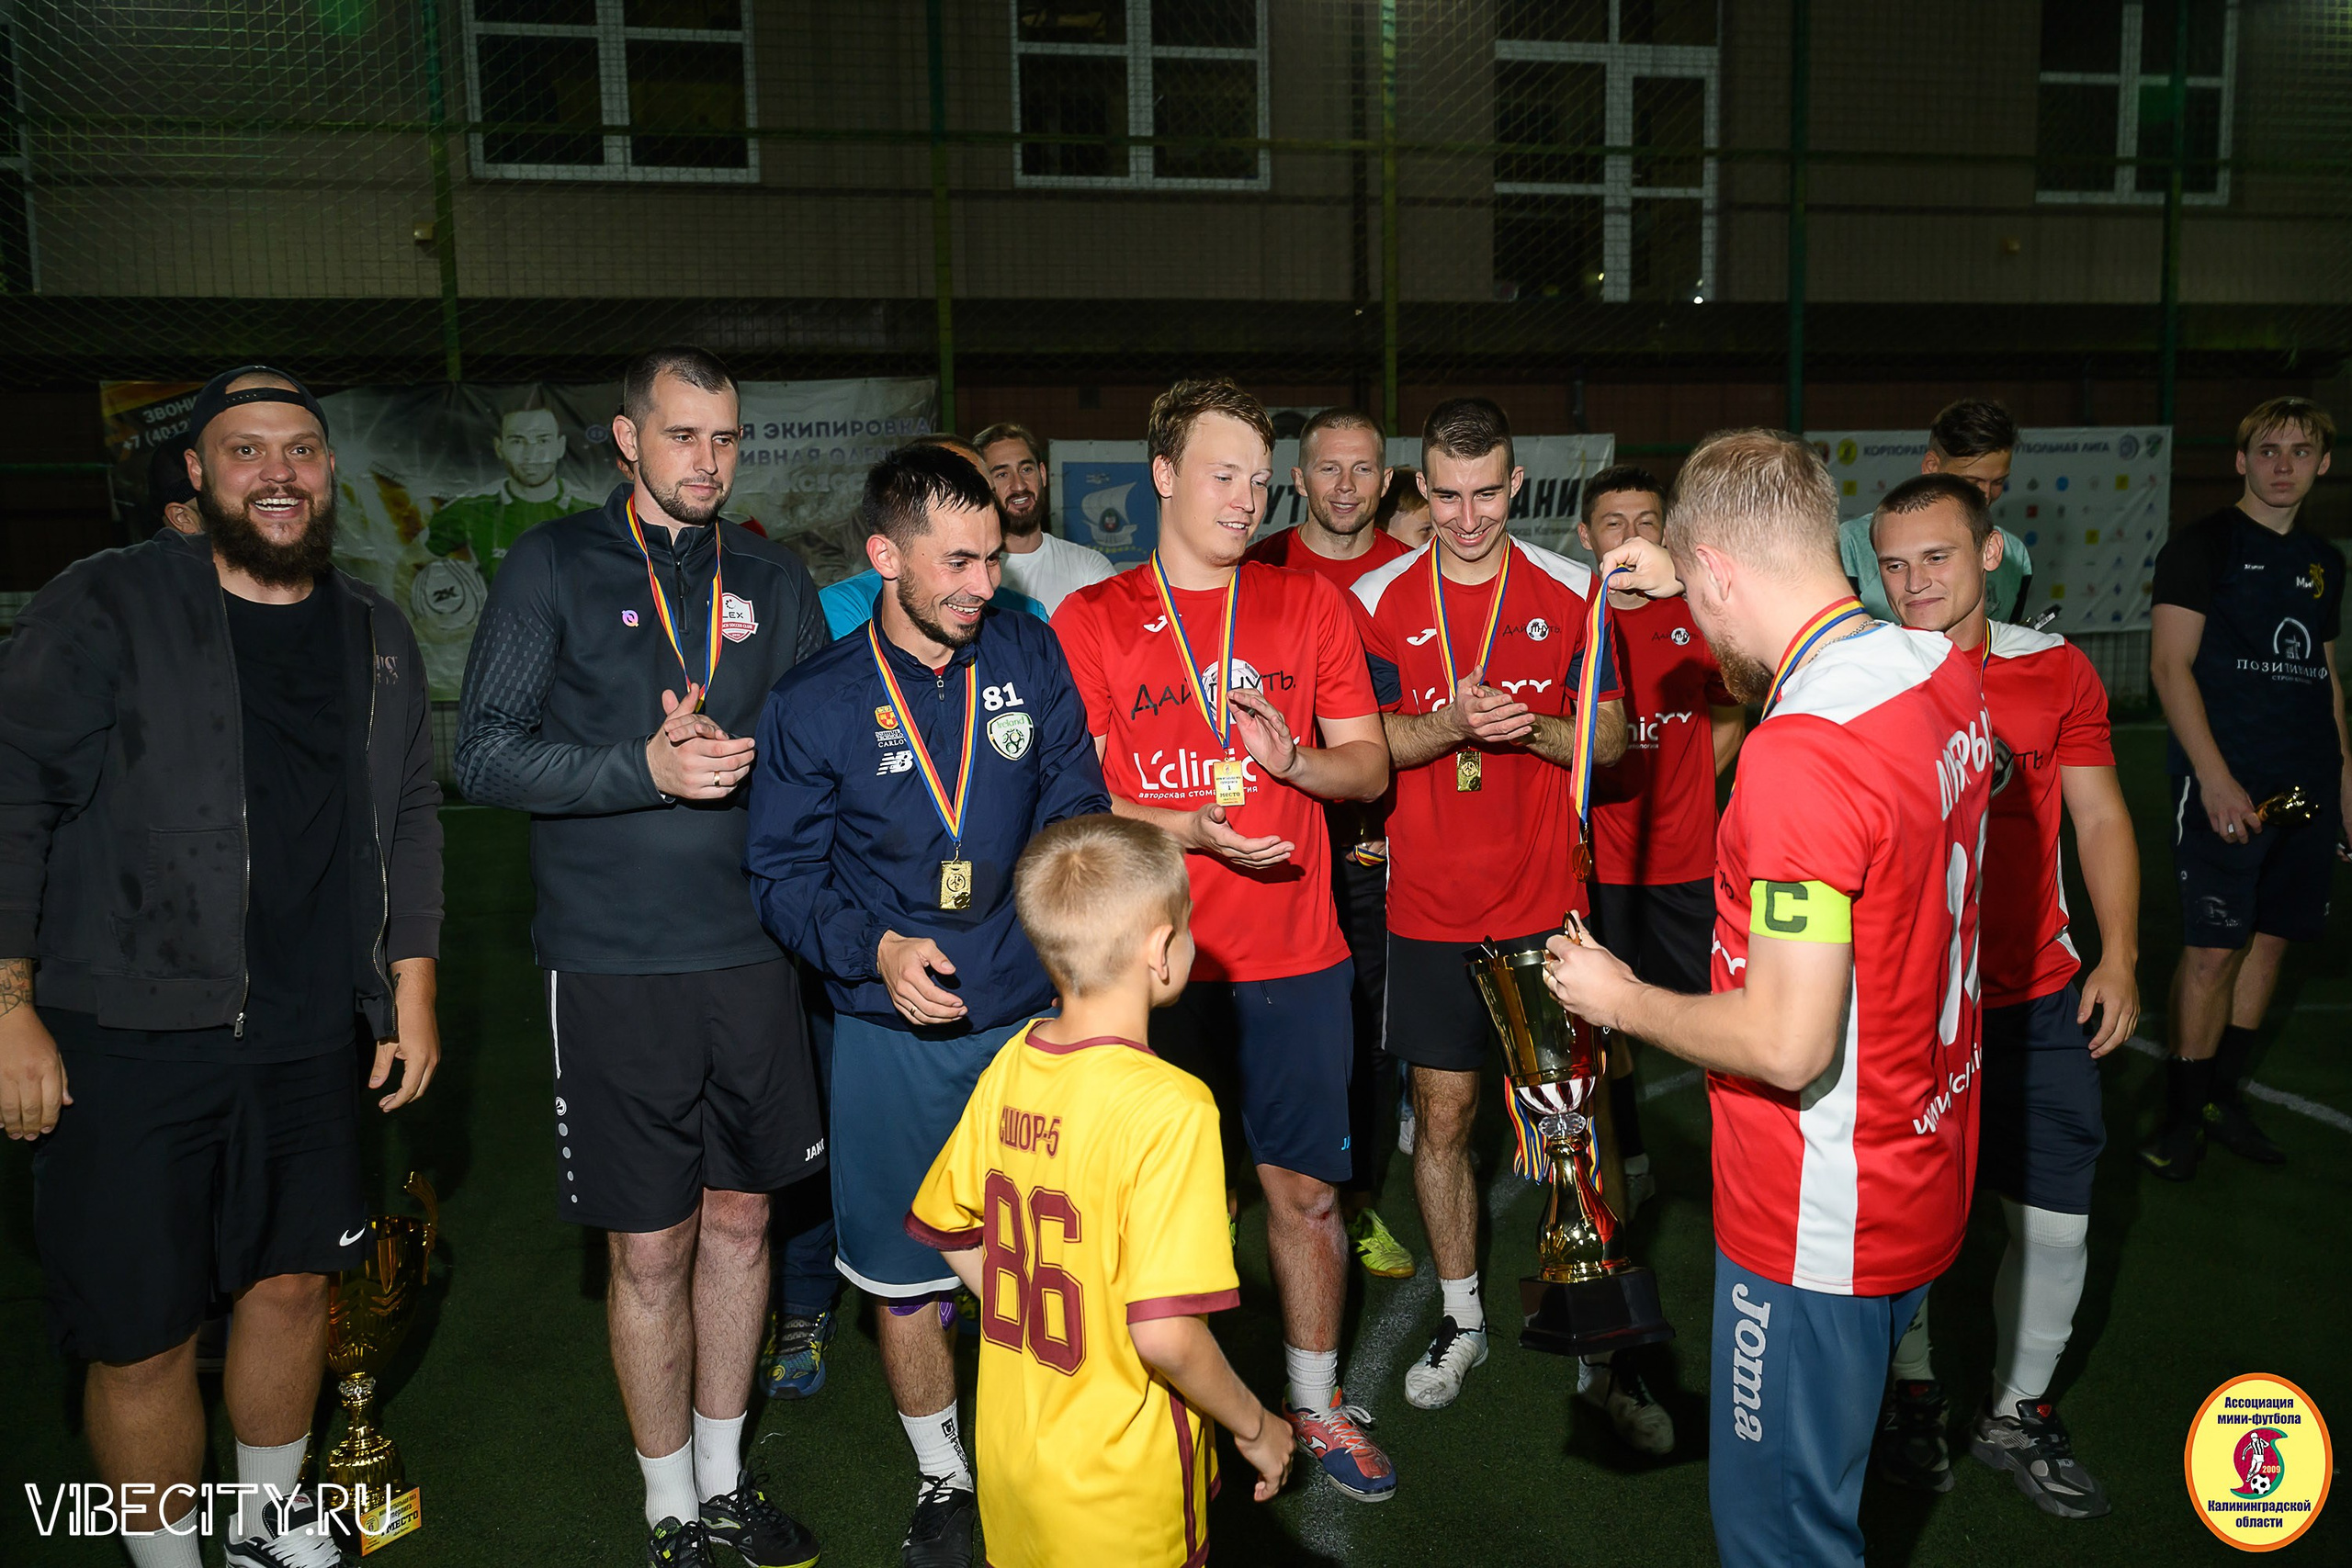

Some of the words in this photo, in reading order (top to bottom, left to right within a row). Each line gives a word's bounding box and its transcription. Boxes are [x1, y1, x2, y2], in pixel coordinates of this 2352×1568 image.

[763, 417, 932, 440] ЭКИПИРОВКА
[740, 447, 820, 467] ИВНАЯ
[1863, 444, 1928, 457] КОРПОРАТ
[2014, 442, 2079, 454] УТБОЛЬНАЯ
[2081, 441, 2111, 453] ЛИГА
[982, 682, 1024, 712] 81
[996, 716, 1025, 729] Ireland
[877, 738, 908, 748] CARLO
[1138, 790, 1186, 800] авторская
[1765, 882, 1809, 933] C
[981, 1168, 1087, 1377] 86
[1731, 1282, 1771, 1443] Joma
